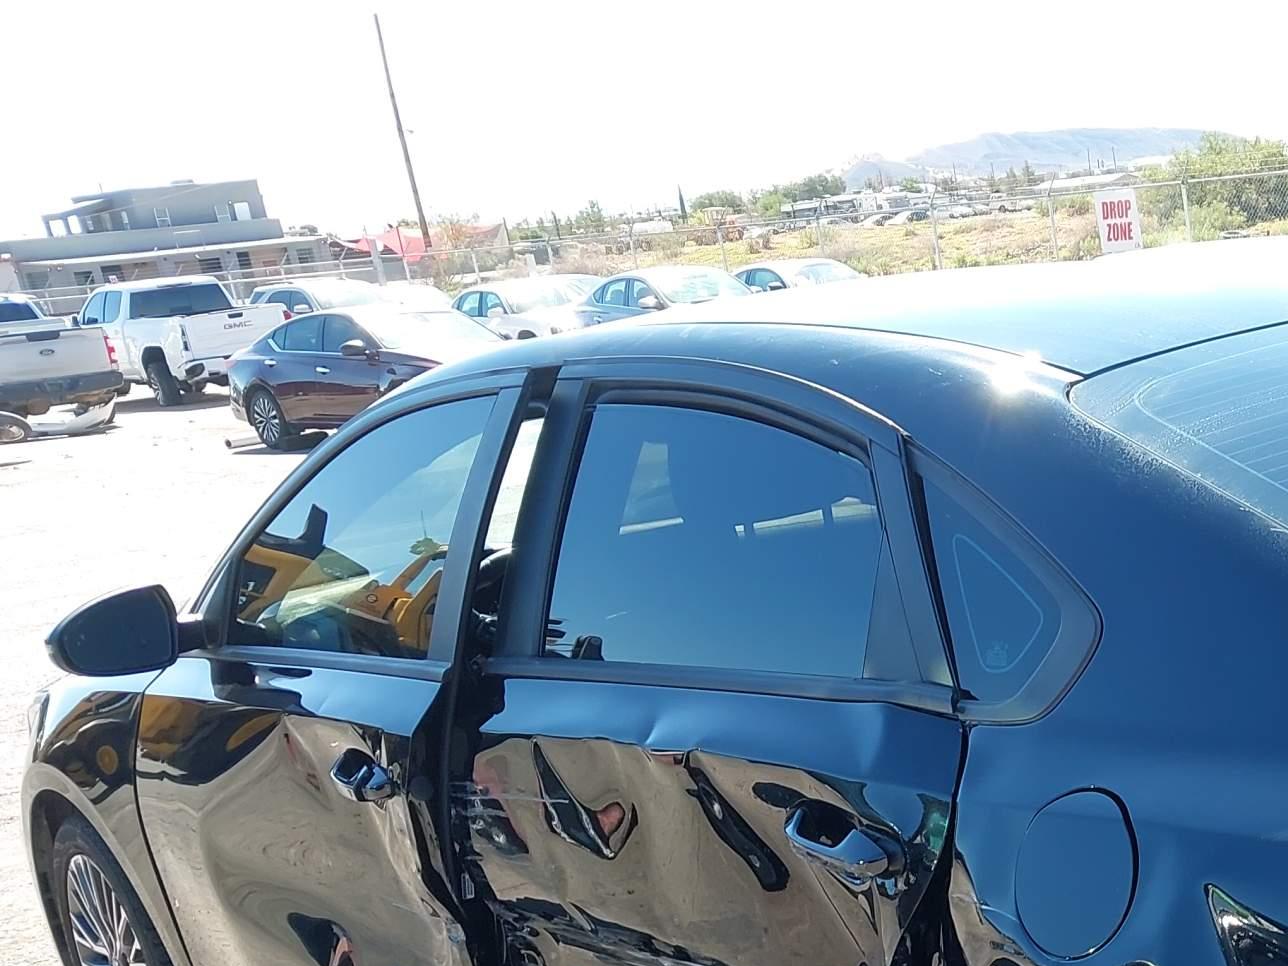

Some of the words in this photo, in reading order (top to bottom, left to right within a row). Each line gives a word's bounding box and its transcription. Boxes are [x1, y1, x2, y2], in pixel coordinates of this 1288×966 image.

[1101, 200, 1131, 220] DROP
[1106, 222, 1134, 242] ZONE
[223, 320, 254, 330] GMC
